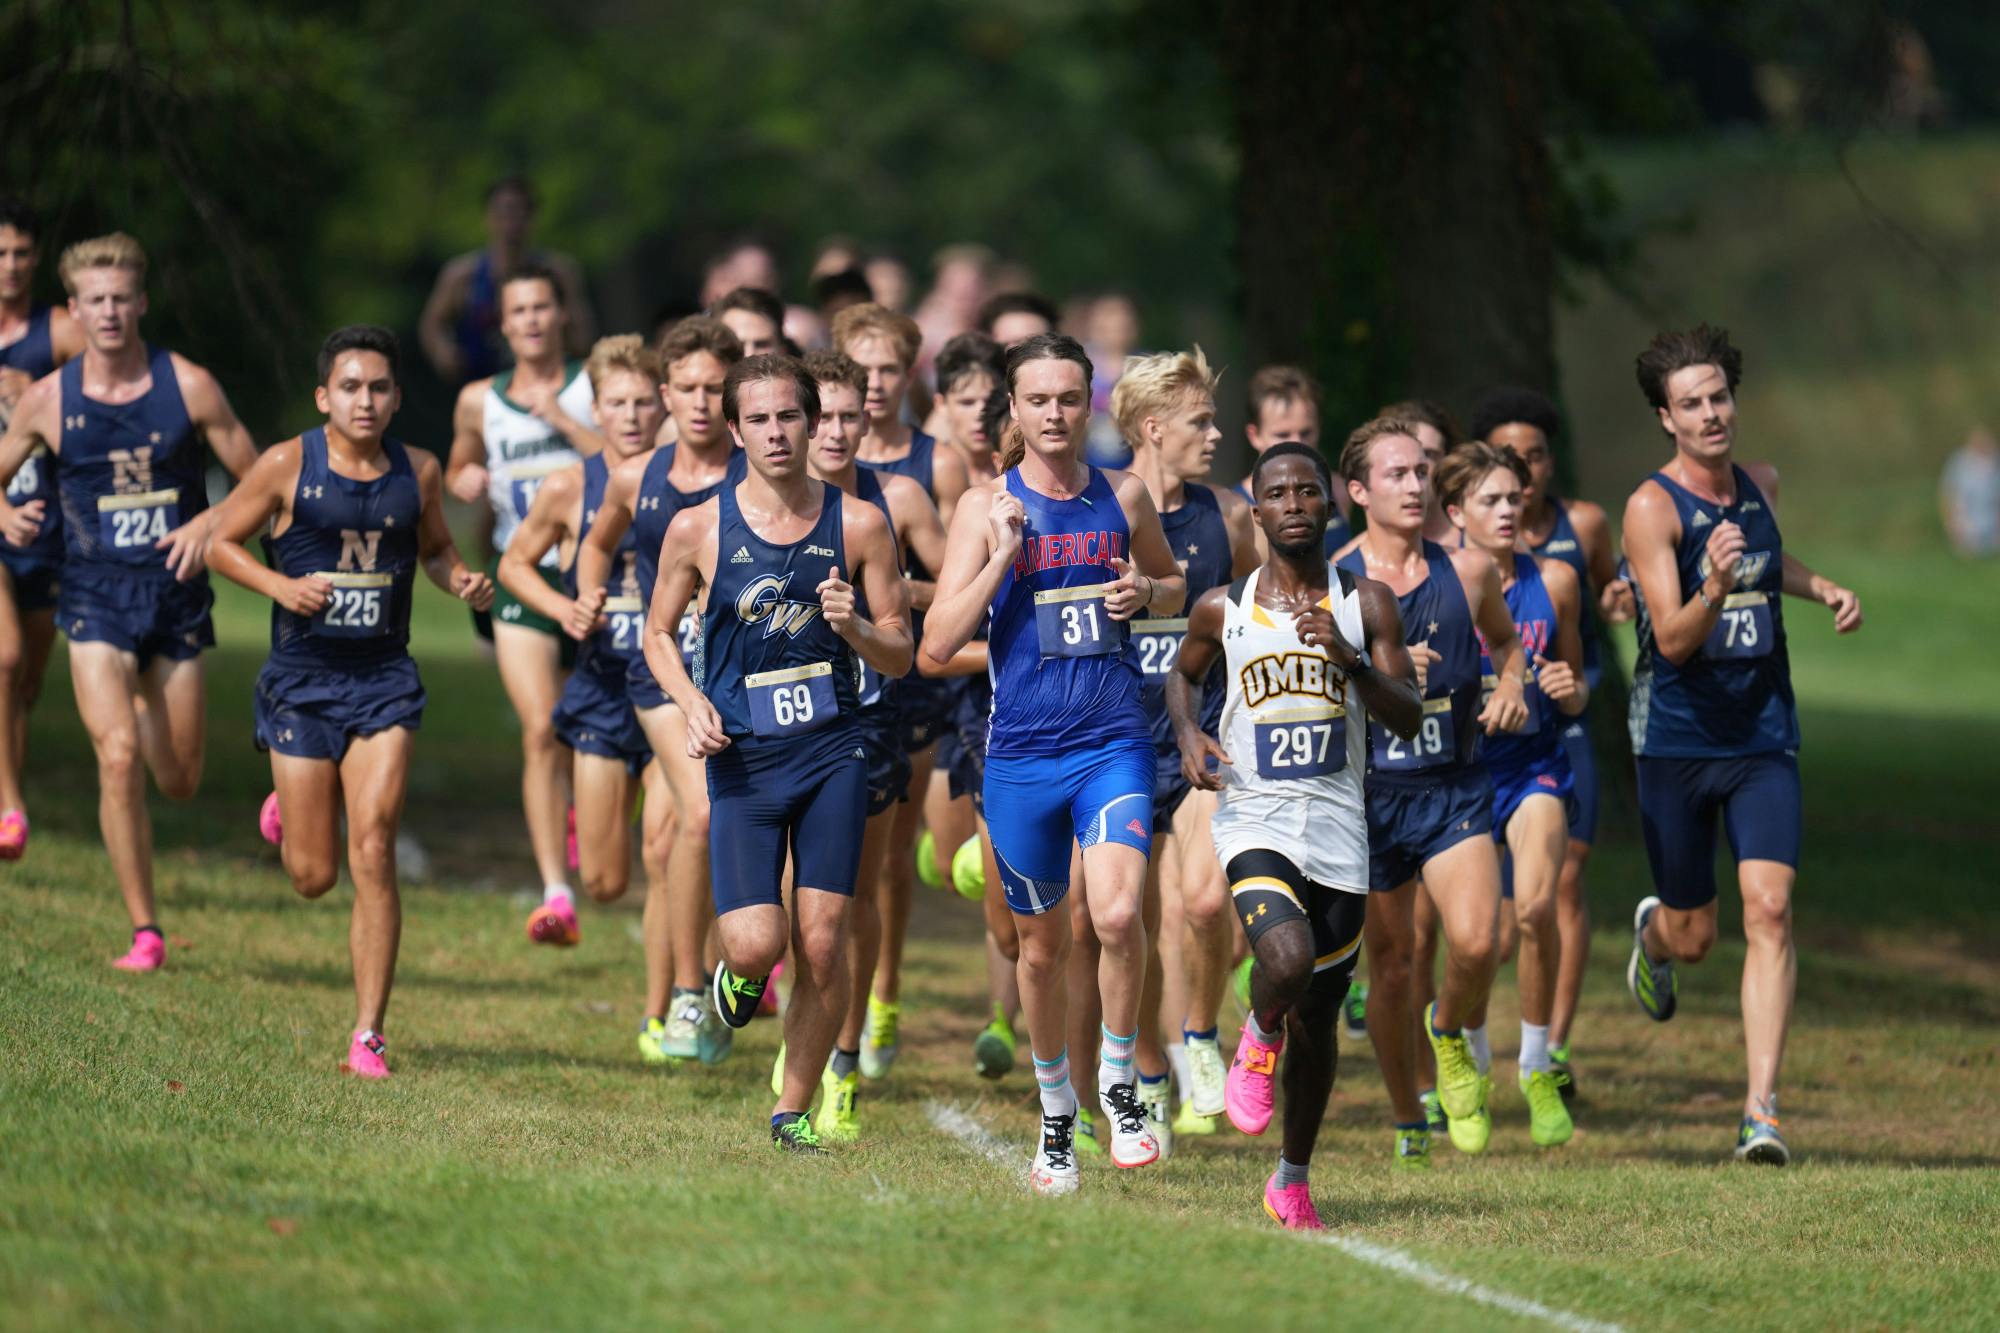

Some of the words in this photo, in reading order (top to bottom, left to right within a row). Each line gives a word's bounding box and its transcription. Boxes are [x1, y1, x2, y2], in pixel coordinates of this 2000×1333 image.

[112, 506, 168, 548] 224
[337, 528, 383, 571] N
[731, 556, 754, 564] adidas
[1014, 531, 1124, 582] AMERICAN
[324, 589, 381, 626] 225
[1062, 603, 1100, 645] 31
[1722, 608, 1758, 648] 73
[1139, 636, 1187, 674] 22
[1240, 652, 1348, 708] UMBC
[773, 684, 814, 726] 69
[1270, 723, 1332, 768] 297
